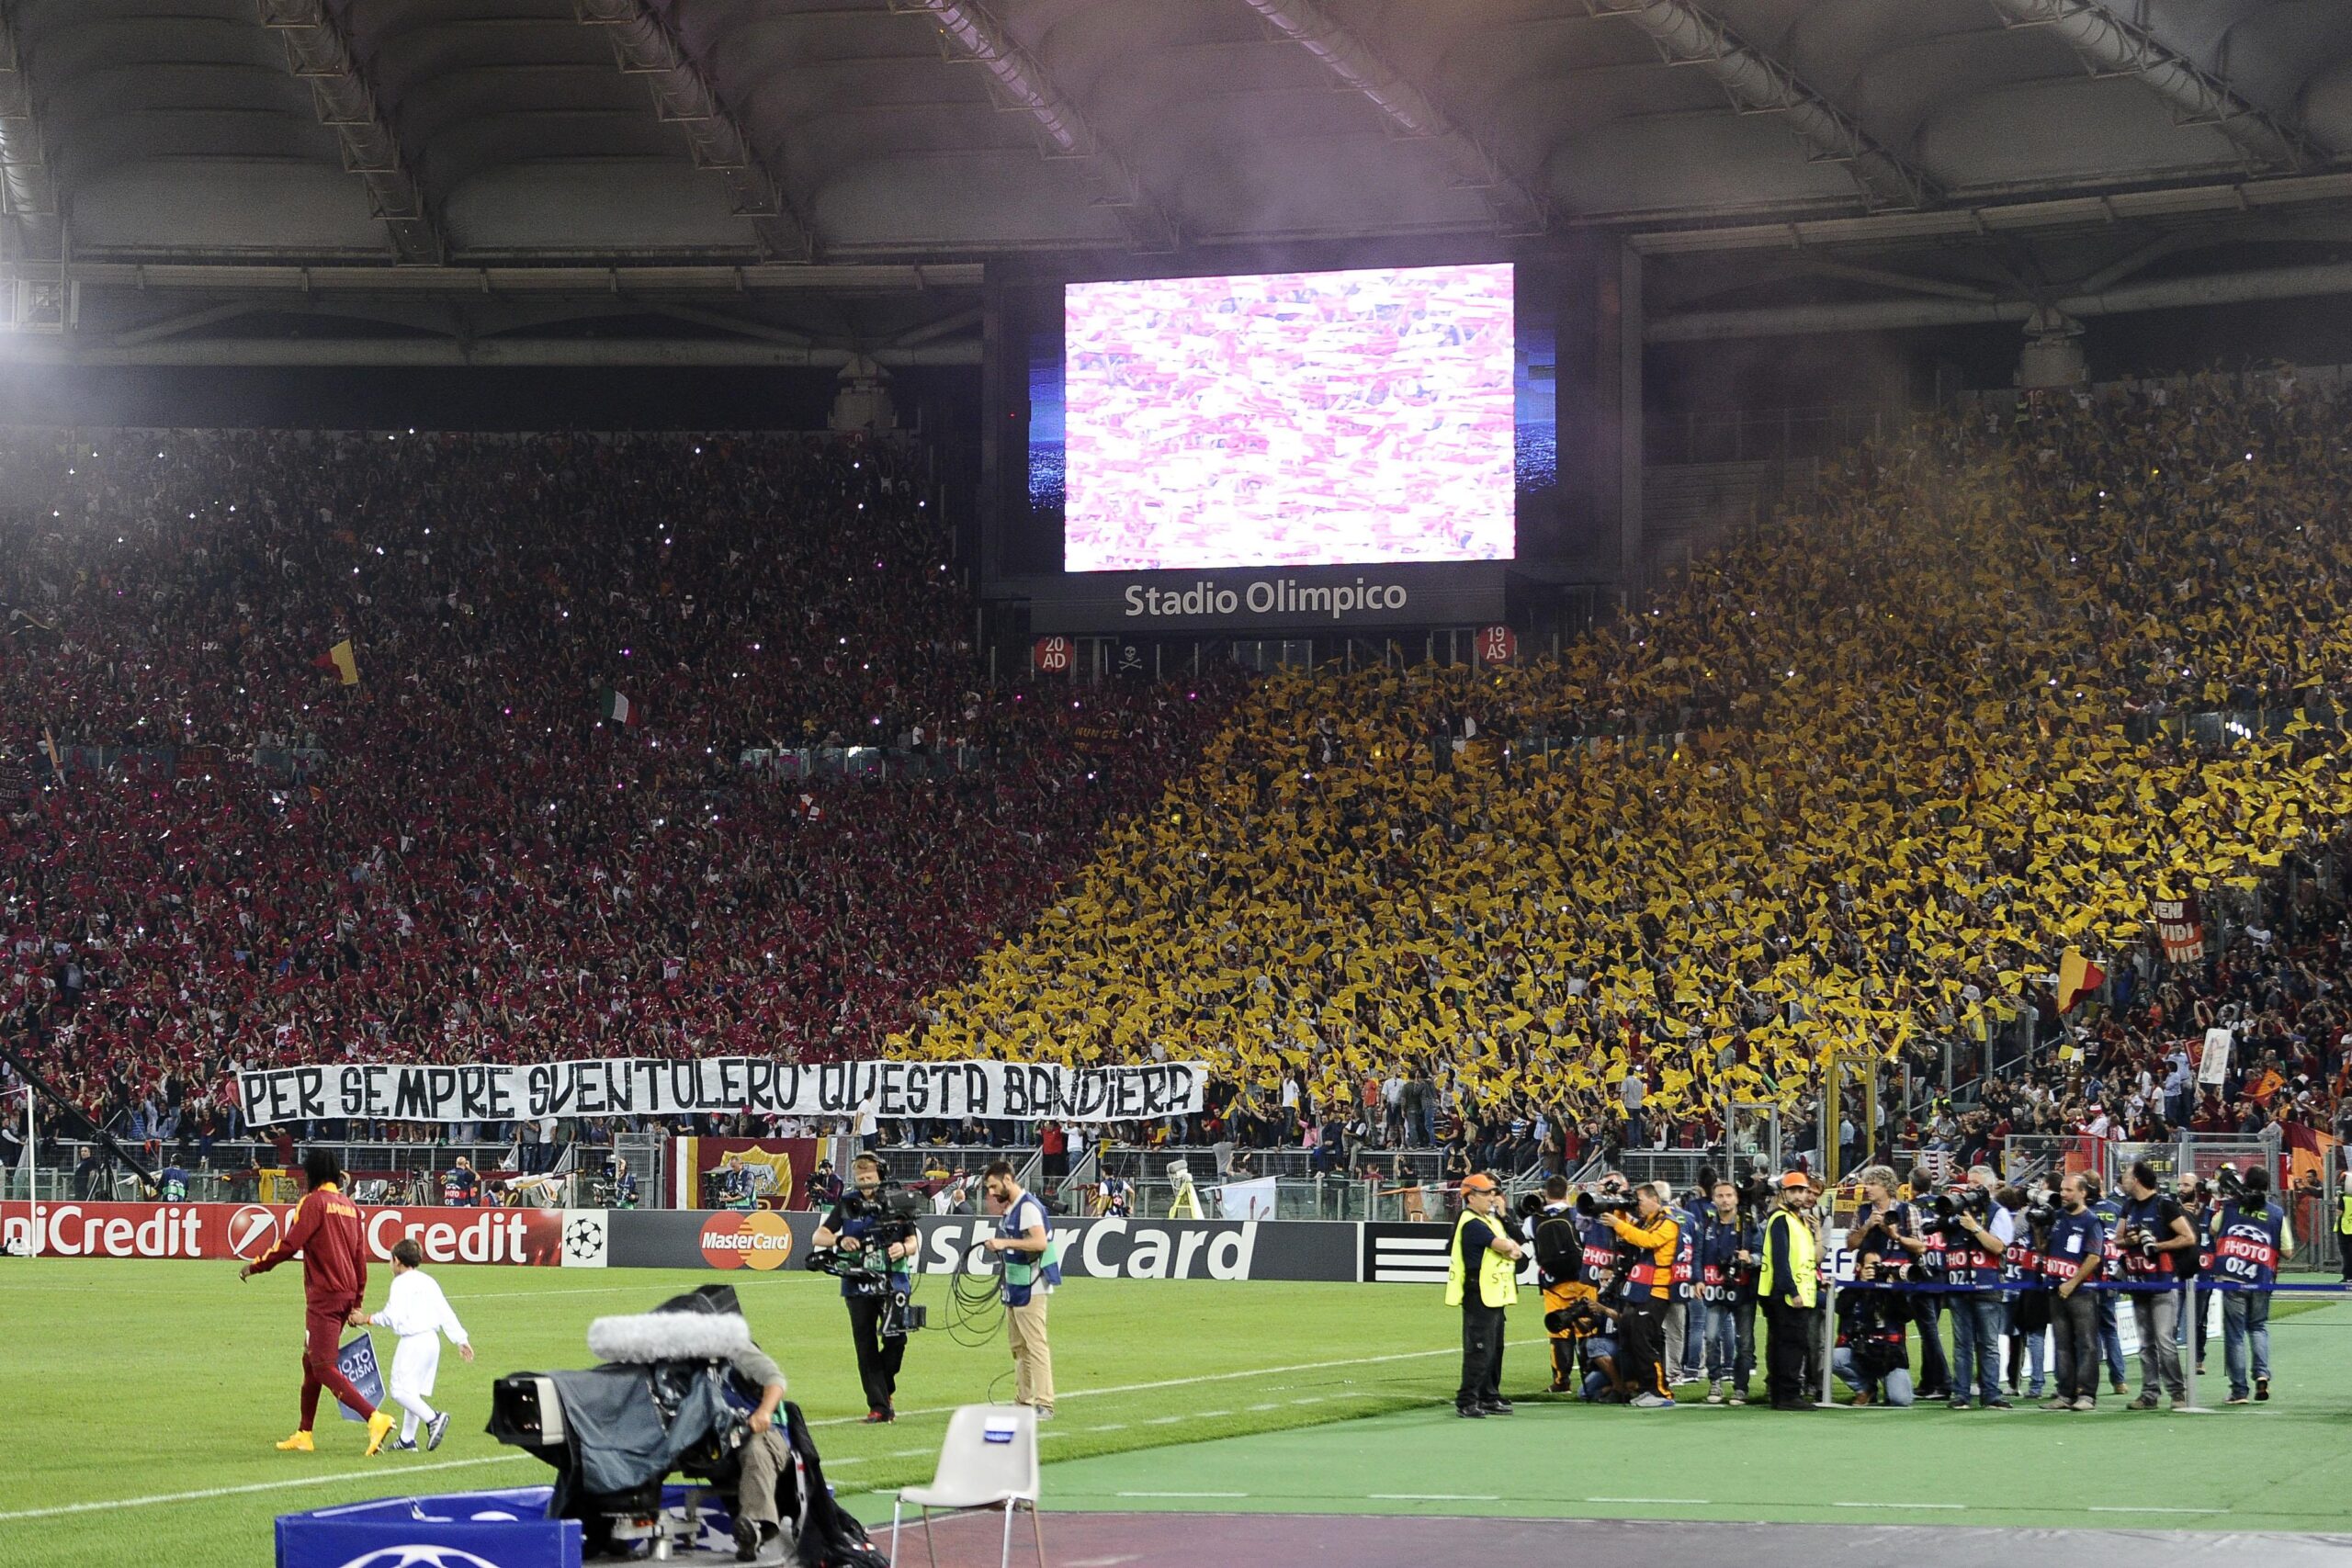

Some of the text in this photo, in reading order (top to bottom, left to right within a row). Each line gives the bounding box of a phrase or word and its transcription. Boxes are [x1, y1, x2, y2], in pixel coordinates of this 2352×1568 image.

[1125, 577, 1408, 619] Stadio Olimpico
[1045, 636, 1065, 652] 20
[1487, 626, 1505, 642] 19
[1042, 653, 1067, 669] AD
[1486, 643, 1507, 660] AS
[2159, 921, 2195, 942] VIDI
[241, 1066, 325, 1124] PER
[340, 1066, 515, 1119] SEMPRE
[819, 1062, 989, 1115] QUESTA
[0, 1204, 202, 1258] niCredit
[285, 1208, 528, 1263] Credit
[701, 1231, 789, 1250] MasterCard
[815, 1213, 1258, 1280] strCard
[2223, 1240, 2271, 1262] PHOTO
[2225, 1256, 2258, 1280] 024
[337, 1348, 371, 1376] O TO
[348, 1360, 375, 1383] CISM
